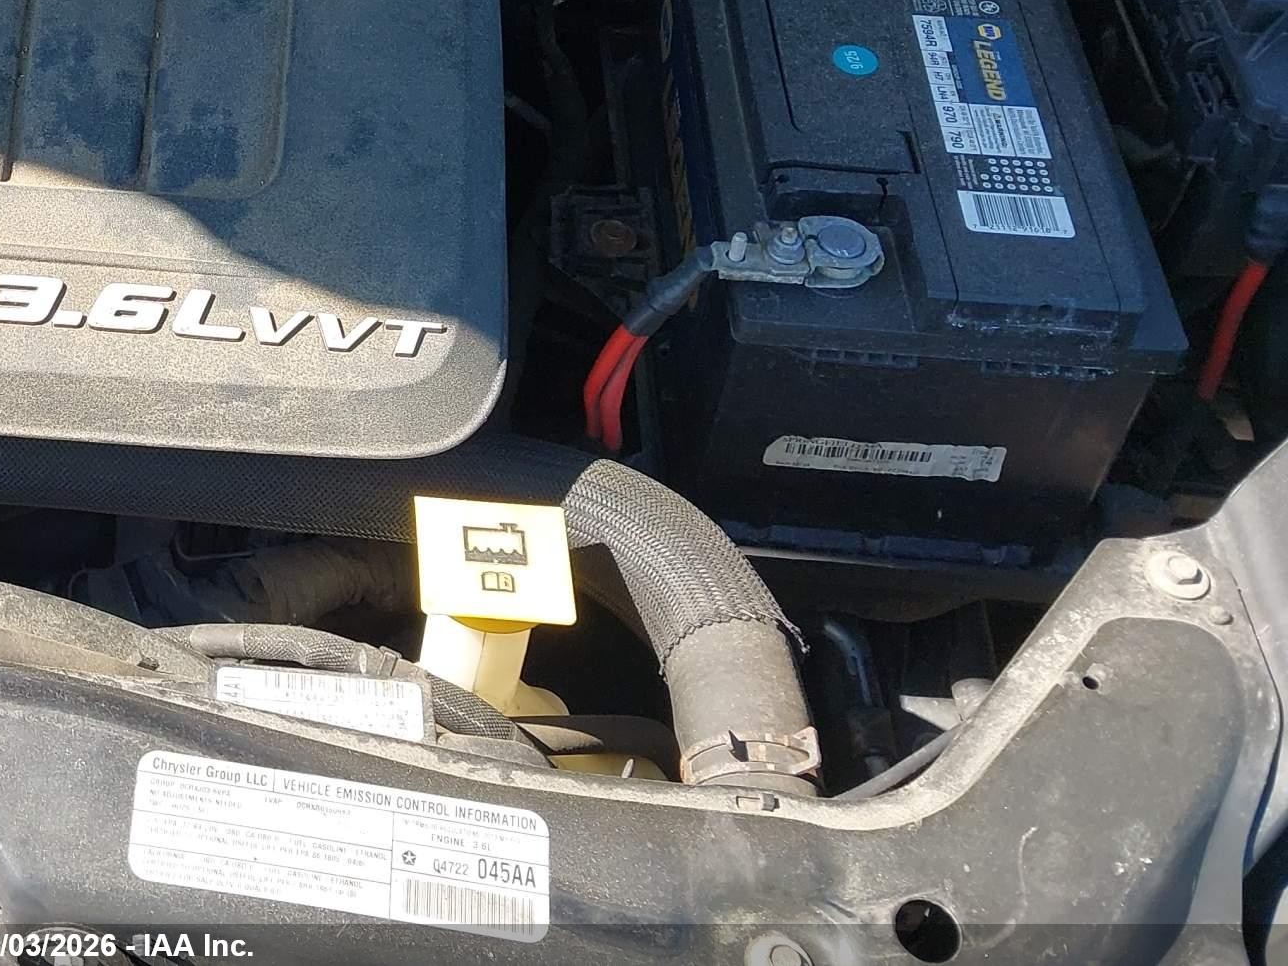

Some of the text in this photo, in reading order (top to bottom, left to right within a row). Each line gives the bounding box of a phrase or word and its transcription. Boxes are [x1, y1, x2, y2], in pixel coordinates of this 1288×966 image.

[920, 19, 937, 47] 7594R
[843, 50, 864, 69] 9/25
[974, 40, 1006, 100] LEGEND
[933, 71, 944, 81] H7
[943, 106, 958, 123] 970
[948, 131, 964, 149] 790
[249, 305, 448, 358] VVT
[152, 757, 200, 776] Chrysler
[206, 765, 241, 783] Group
[246, 770, 268, 787] LLC
[283, 778, 330, 797] VEHICLE
[336, 787, 392, 806] EMISSION
[396, 796, 450, 816] CONTROL
[455, 805, 537, 831] INFORMATION
[431, 833, 465, 847] ENGINE
[478, 858, 537, 888] 045AA
